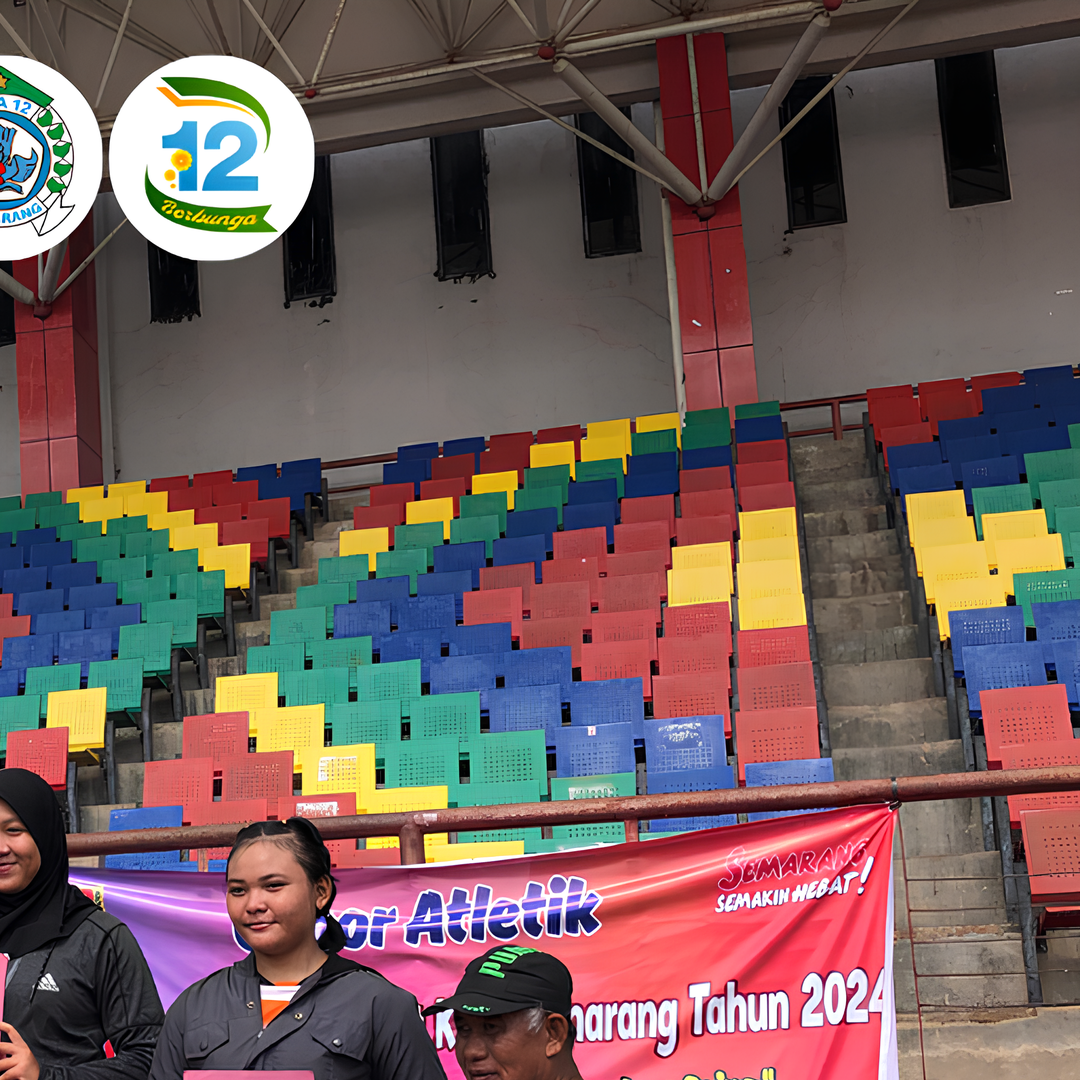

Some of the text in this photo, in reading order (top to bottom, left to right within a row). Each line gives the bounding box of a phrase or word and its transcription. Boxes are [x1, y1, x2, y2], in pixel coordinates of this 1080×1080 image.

[715, 855, 875, 913] SEMAKIN HEBAT!
[717, 838, 871, 891] SEMARANG
[404, 873, 604, 947] Atletik
[687, 980, 792, 1036] Tahun
[799, 967, 887, 1028] 2024
